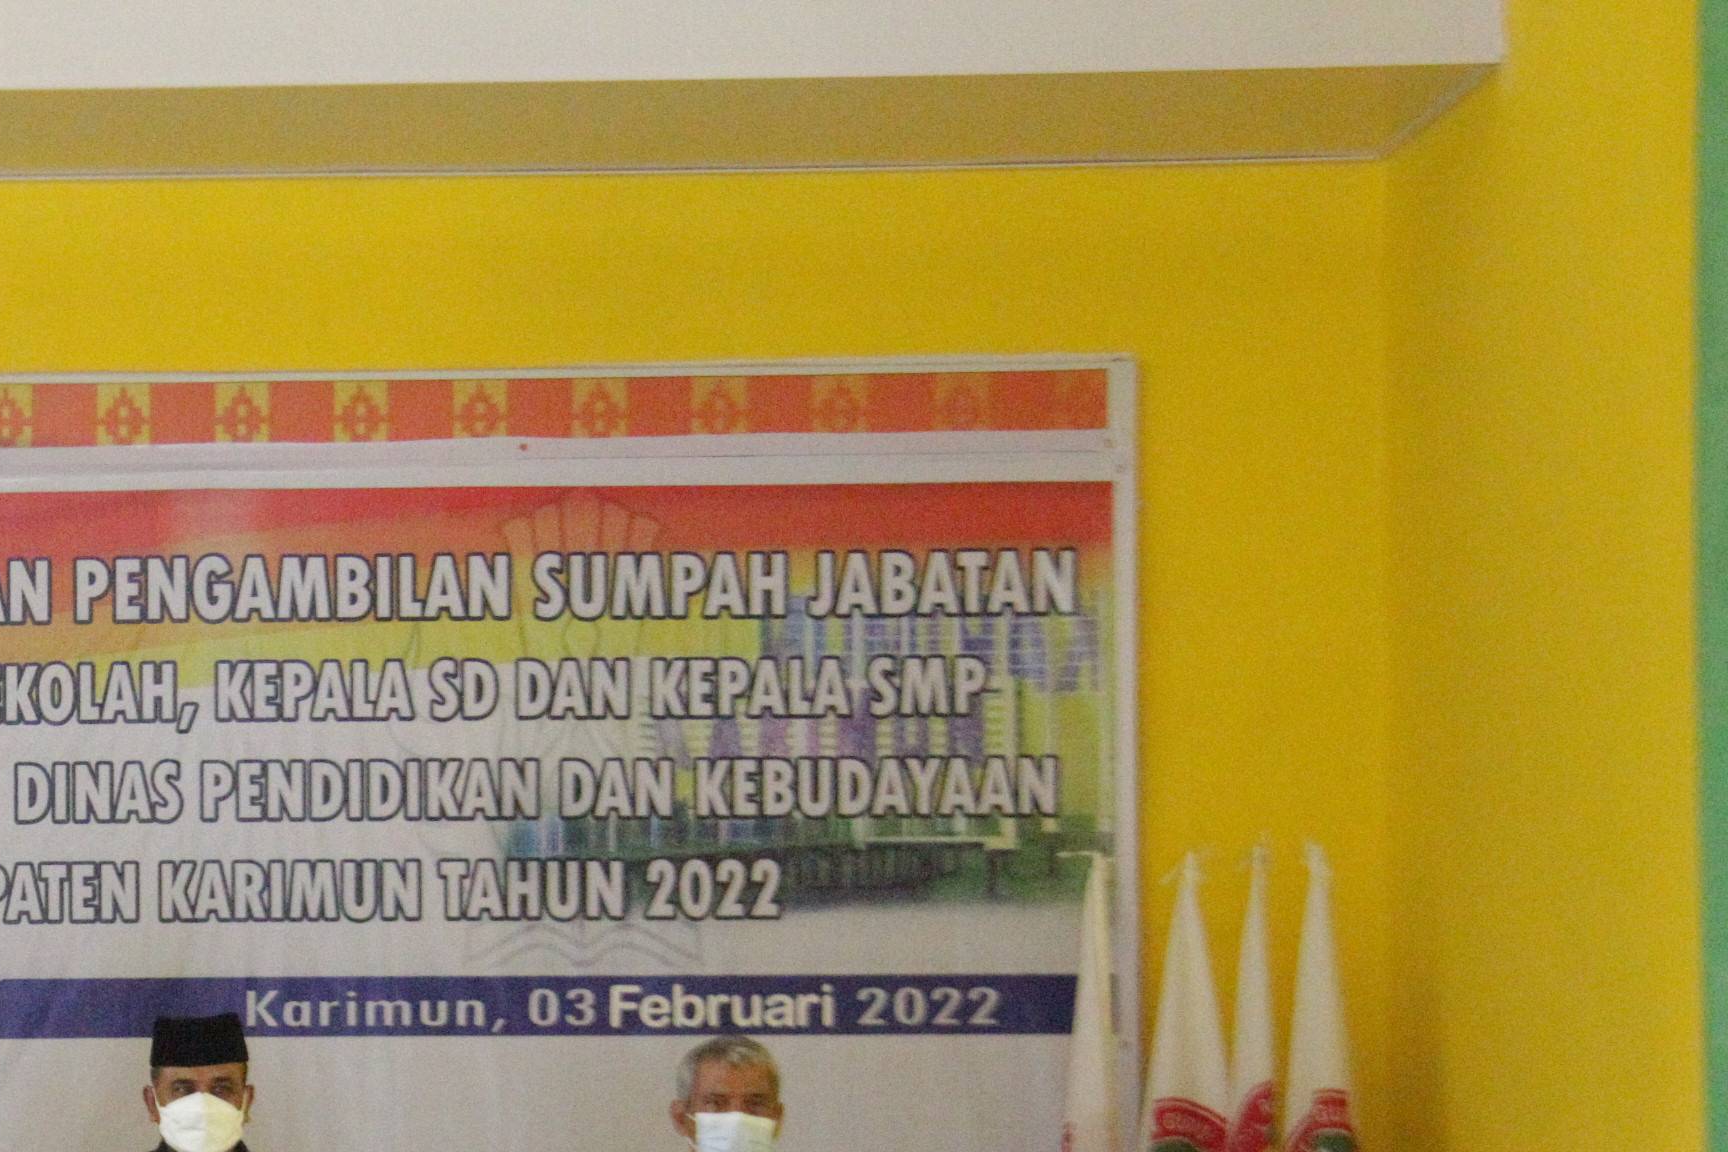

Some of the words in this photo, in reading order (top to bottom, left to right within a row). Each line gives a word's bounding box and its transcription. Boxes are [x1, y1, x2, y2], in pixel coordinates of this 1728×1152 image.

[72, 552, 512, 625] PENGAMBILAN
[532, 550, 788, 621] SUMPAH
[806, 548, 1076, 619] JABATAN
[214, 657, 416, 724] KEPALA
[427, 656, 499, 722] SD
[516, 656, 633, 720] DAN
[649, 655, 850, 720] KEPALA
[870, 655, 987, 719] SMP
[13, 759, 183, 826] DINAS
[199, 757, 539, 823] PENDIDIKAN
[558, 757, 674, 821] DAN
[693, 755, 1062, 818] KEBUDAYAAN
[157, 858, 421, 923] KARIMUN
[436, 857, 627, 922] TAHUN
[643, 857, 783, 922] 2022
[246, 989, 506, 1033] Karimun,
[527, 987, 597, 1028] 03
[608, 983, 835, 1029] Februari
[856, 986, 1001, 1026] 2022
